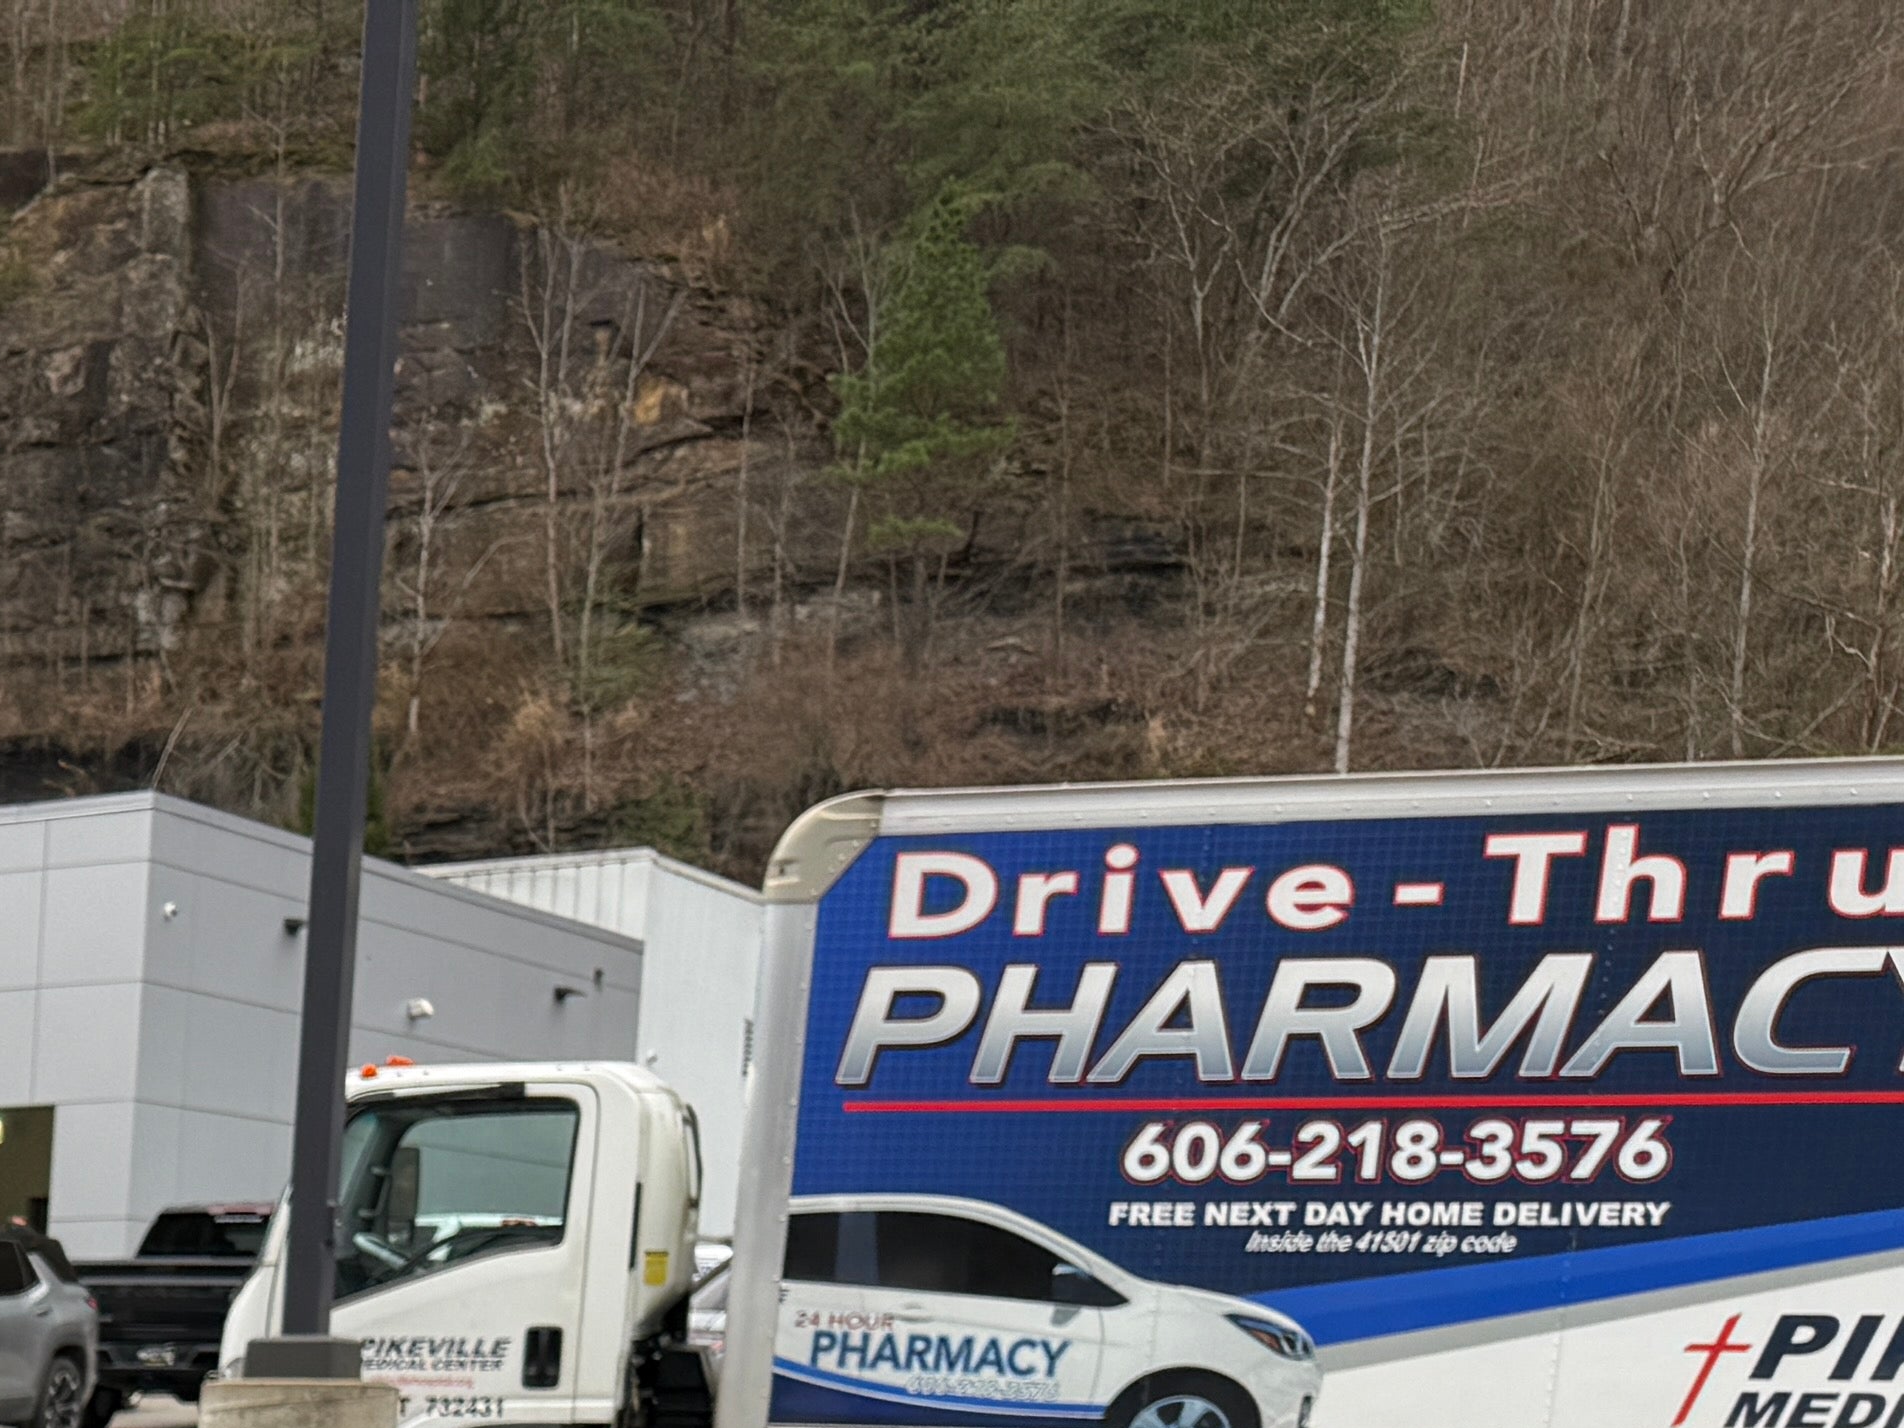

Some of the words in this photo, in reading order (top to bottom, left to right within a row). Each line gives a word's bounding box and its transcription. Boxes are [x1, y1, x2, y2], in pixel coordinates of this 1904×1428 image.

[836, 945, 1904, 1088] PHARMAC
[1121, 1116, 1672, 1184] 606-218-3576
[1109, 1201, 1195, 1227] FREE
[1204, 1201, 1295, 1227] NEXT
[1304, 1201, 1372, 1227] DAY
[1381, 1201, 1483, 1227] HOME
[1493, 1201, 1671, 1227] DELIVERY
[1245, 1231, 1314, 1254] Inside
[1318, 1231, 1353, 1253] the
[1355, 1231, 1422, 1253] 41501
[1423, 1231, 1459, 1257] zip
[1461, 1231, 1517, 1254] code
[794, 1309, 820, 1329] 24
[829, 1310, 894, 1331] HOUR
[362, 1359, 428, 1371] EDICAL
[433, 1359, 505, 1372] CENTER
[809, 1329, 1072, 1377] PHARMACY
